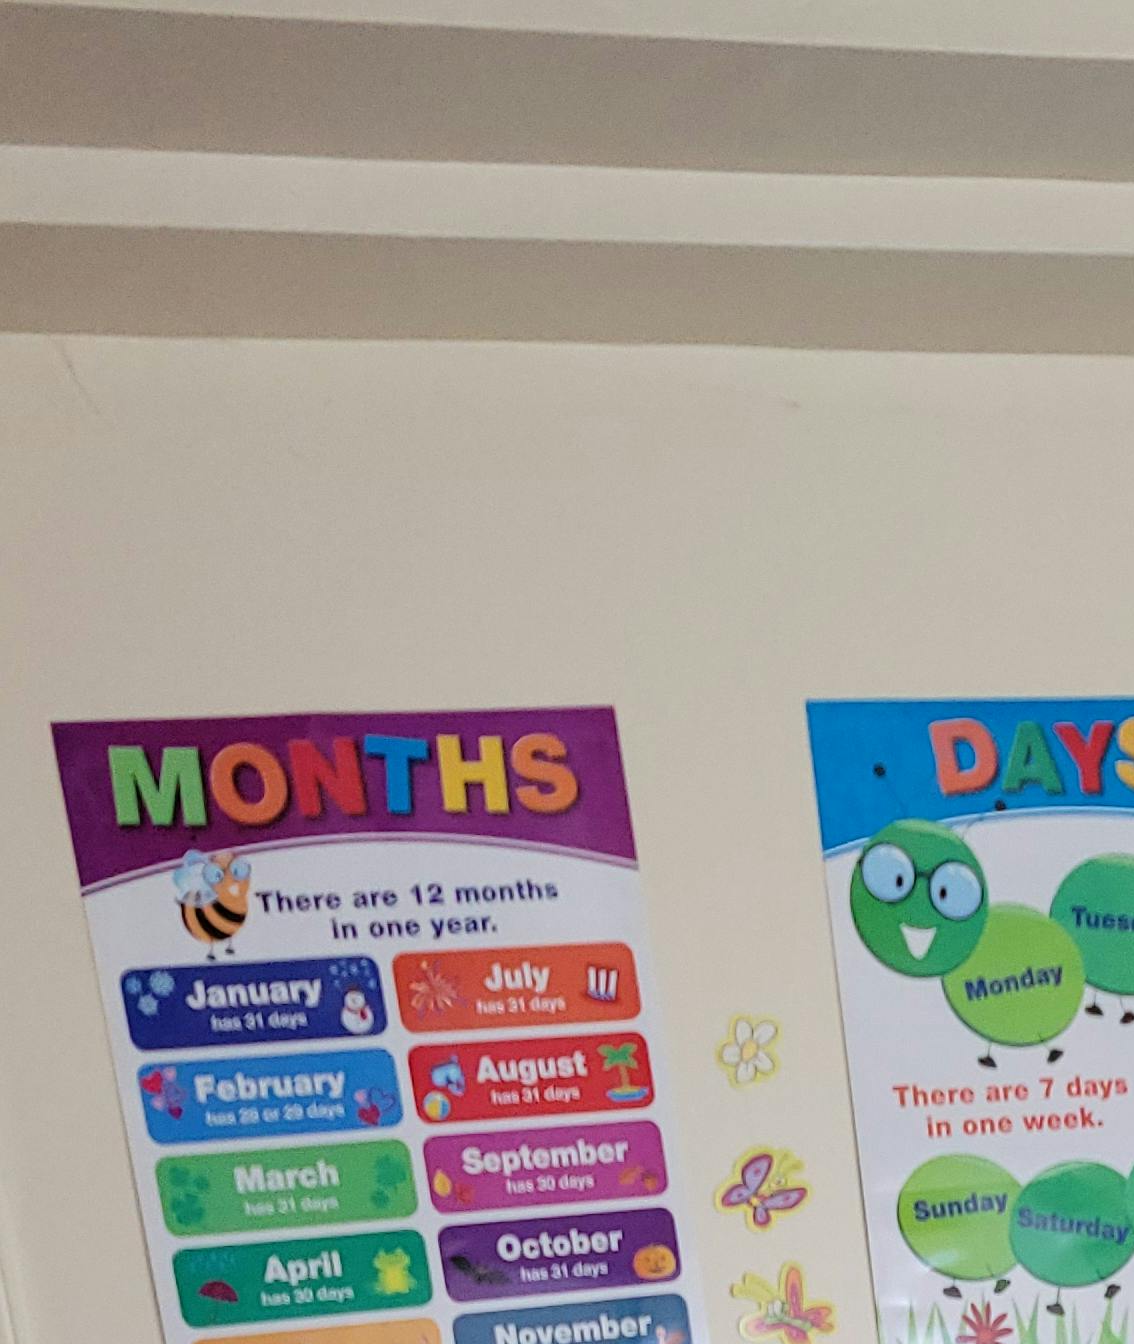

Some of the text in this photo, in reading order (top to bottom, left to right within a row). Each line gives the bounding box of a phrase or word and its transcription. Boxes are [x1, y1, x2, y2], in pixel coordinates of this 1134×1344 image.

[108, 733, 578, 827] MONTHS
[255, 879, 558, 914] There are 12 months
[331, 915, 498, 940] in one year.
[484, 962, 550, 992] July
[964, 964, 1064, 1003] Monday
[186, 979, 322, 1010] January
[477, 1051, 588, 1085] August
[194, 1071, 345, 1104] February
[893, 1074, 1129, 1109] There are 7 days
[926, 1106, 1104, 1138] in one week.
[462, 1138, 628, 1175] September
[234, 1159, 340, 1194] March
[914, 1191, 1008, 1223] Sunday
[1017, 1207, 1131, 1244] Saturday
[497, 1228, 623, 1262] October
[264, 1250, 343, 1287] April
